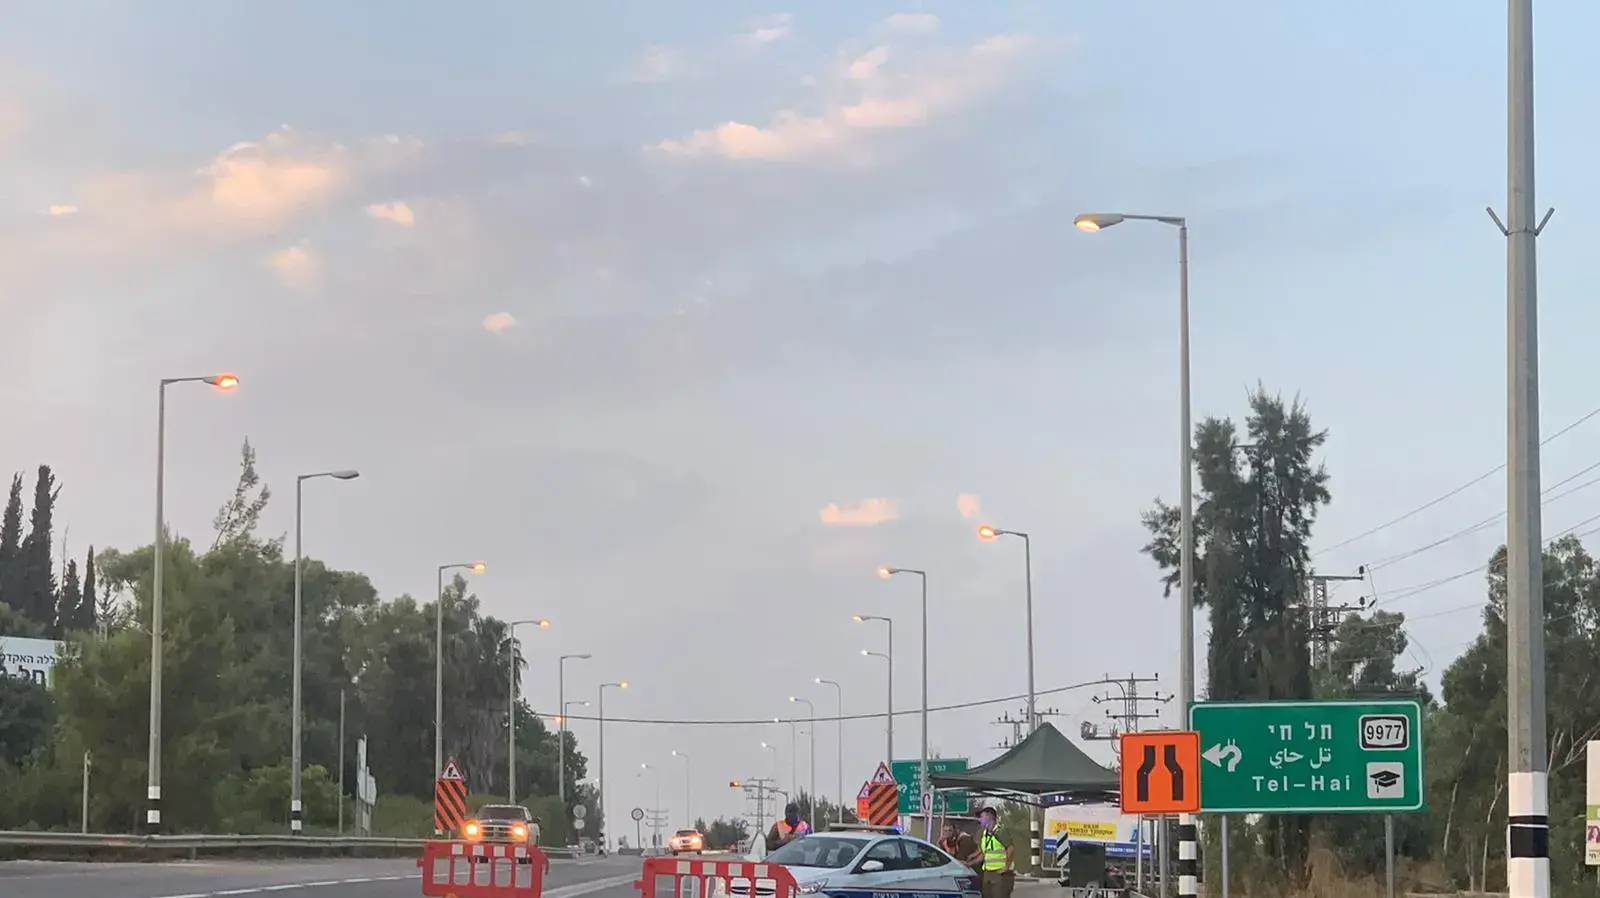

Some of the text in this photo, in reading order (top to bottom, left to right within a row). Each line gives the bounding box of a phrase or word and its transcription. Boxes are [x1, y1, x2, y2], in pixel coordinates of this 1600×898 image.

[1268, 722, 1332, 741] תל חי
[1366, 725, 1402, 740] 9977
[1269, 747, 1331, 769] تل حاي
[1252, 775, 1350, 792] Tel-Hai
